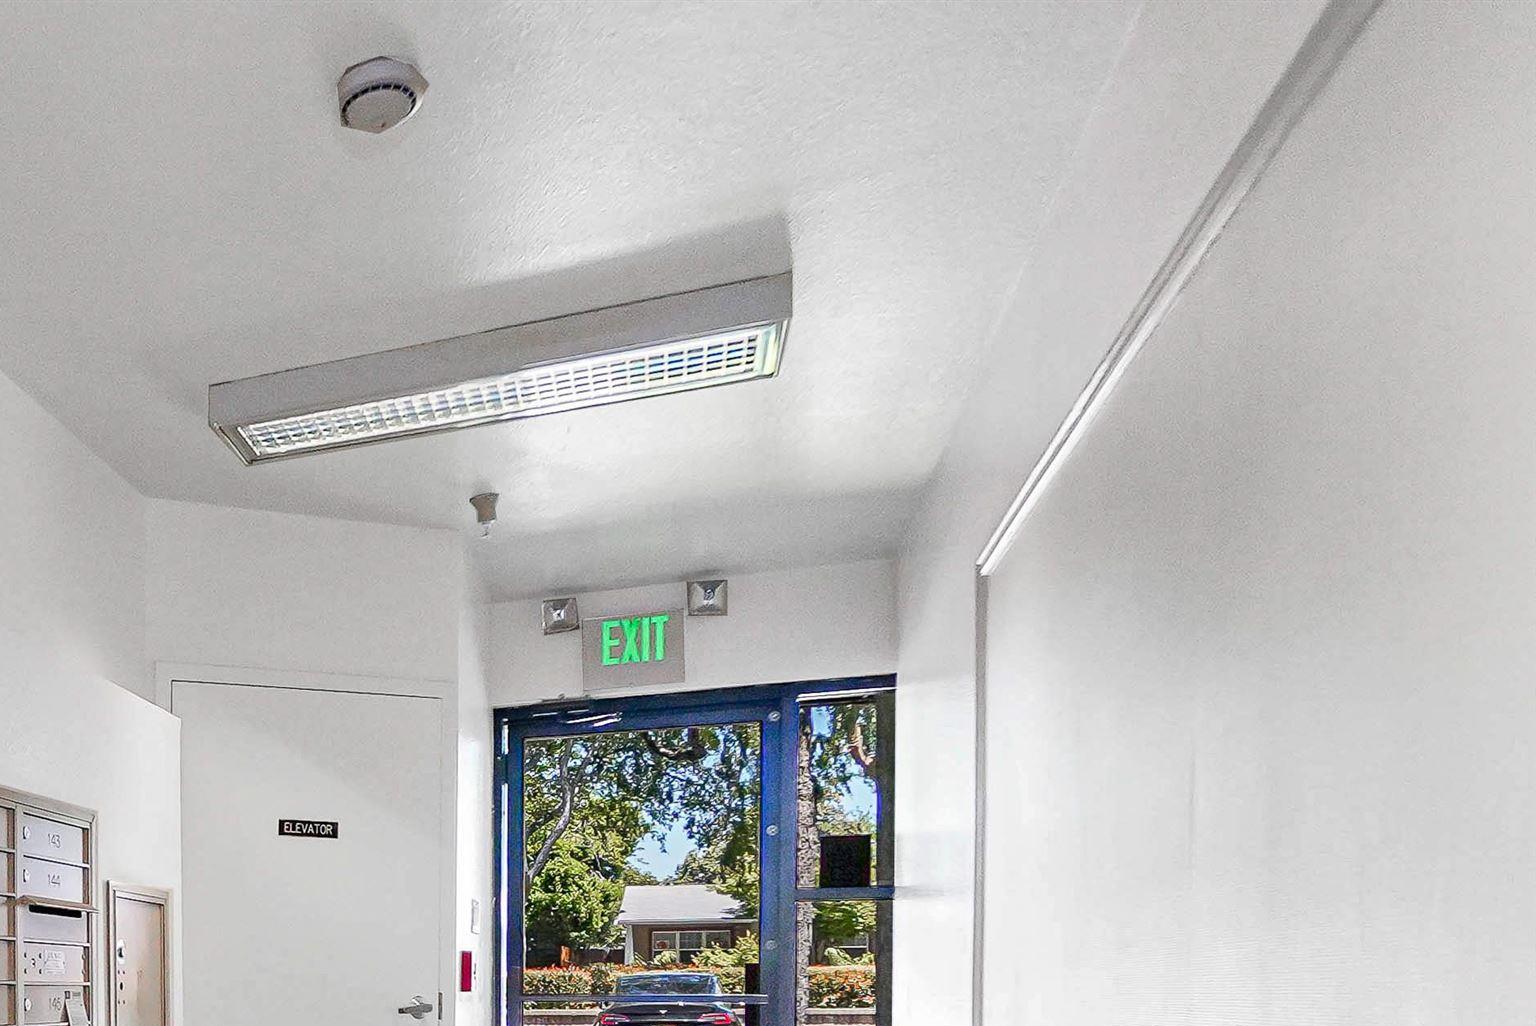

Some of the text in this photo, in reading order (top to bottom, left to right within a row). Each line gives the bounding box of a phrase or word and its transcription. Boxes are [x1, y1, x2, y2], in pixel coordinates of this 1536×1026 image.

[600, 613, 669, 666] EXIT
[284, 822, 333, 835] ELEVATOR
[47, 832, 61, 849] 143
[47, 873, 61, 886] 144
